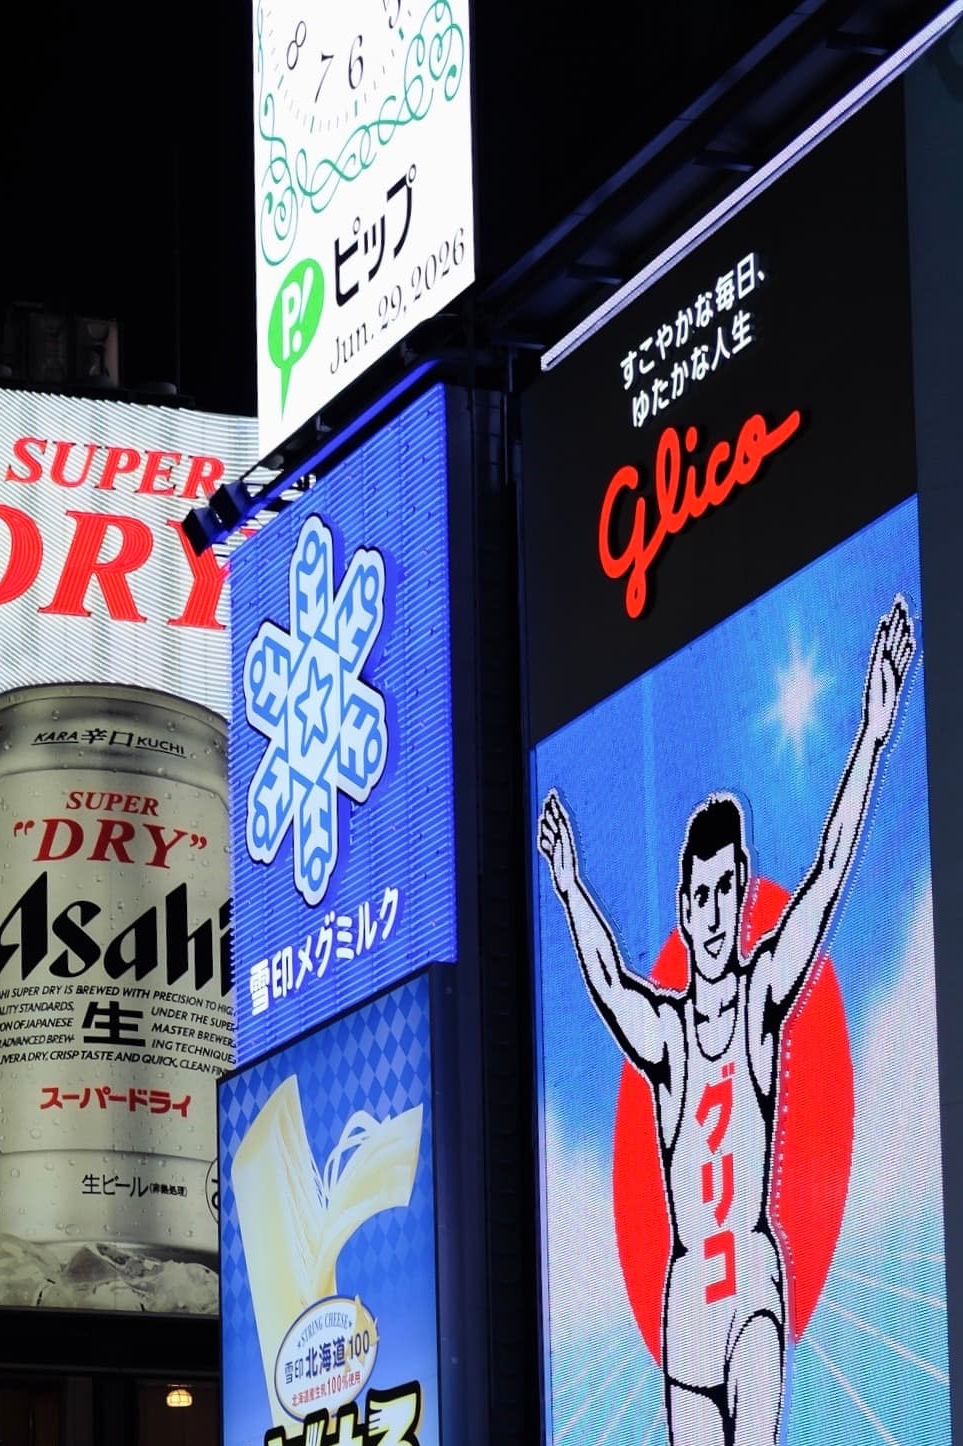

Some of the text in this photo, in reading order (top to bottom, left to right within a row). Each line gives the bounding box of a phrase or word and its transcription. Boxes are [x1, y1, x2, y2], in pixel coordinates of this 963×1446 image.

[286, 20, 307, 71] 8
[347, 34, 364, 90] 6
[314, 53, 335, 103] 7
[334, 163, 417, 308] ピップ
[329, 226, 466, 375] Jun. 29, 2026
[620, 252, 766, 390] すこやかな毎日、
[632, 310, 752, 427] ゆたかな人生
[4, 436, 225, 498] SUPER
[598, 410, 800, 618] Glico
[34, 728, 185, 755] KARA 辛口 KUCHI
[66, 791, 159, 817] SUPER
[248, 886, 400, 1017] 雪印メグミルク
[11, 985, 40, 998] SUPER
[42, 985, 63, 995] DRY
[64, 985, 74, 994] IS
[75, 985, 119, 997] BREWED
[122, 987, 150, 999] WITH
[153, 990, 204, 1007] PRECISION
[205, 999, 217, 1011] TO
[151, 1006, 188, 1021] UNDER
[190, 1013, 208, 1025] THE
[2, 1034, 46, 1048] ADVANCED
[13, 1019, 25, 1031] OF
[24, 1018, 74, 1029] JAPANESE
[82, 1000, 145, 1048] 生
[151, 1022, 195, 1038] MASTER
[151, 1039, 173, 1051] ING
[49, 1050, 80, 1061] CRISP
[80, 1050, 114, 1061] TASTE
[114, 1052, 141, 1063] AND
[180, 1059, 211, 1073] CLEAN
[40, 1085, 192, 1118] スーパードライ
[695, 1060, 736, 1305] グリコ
[324, 1311, 349, 1330] CHEESE
